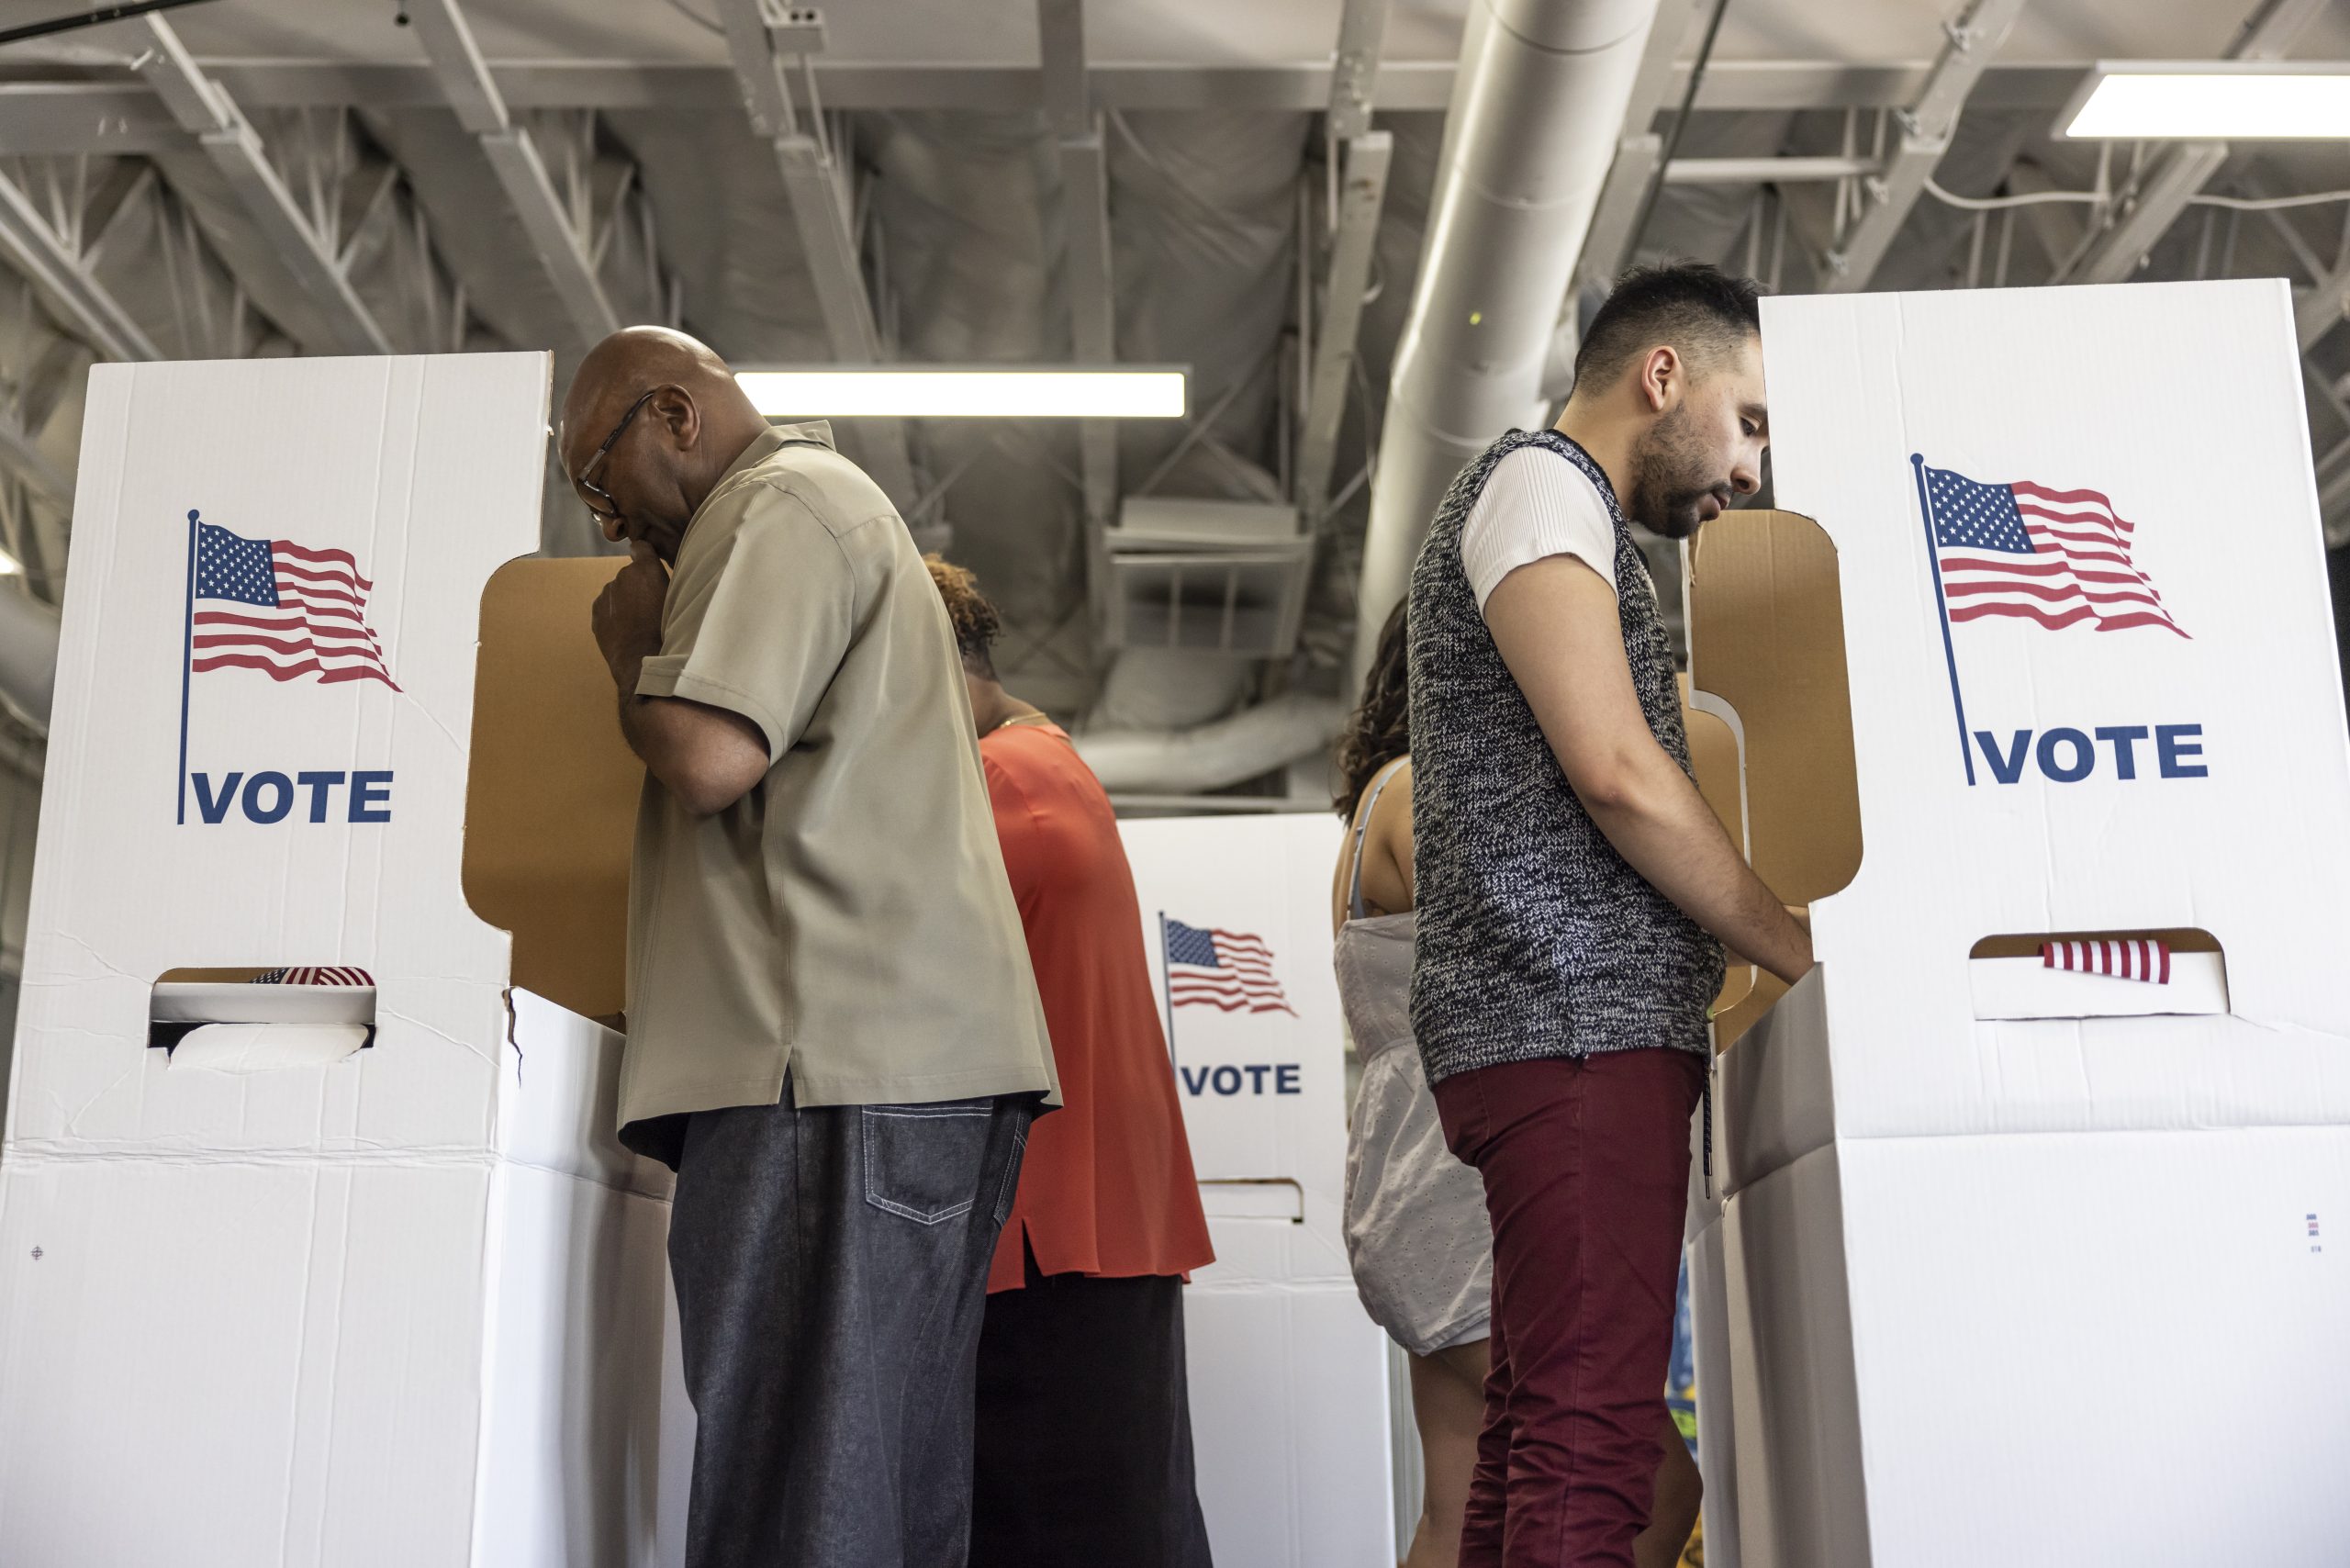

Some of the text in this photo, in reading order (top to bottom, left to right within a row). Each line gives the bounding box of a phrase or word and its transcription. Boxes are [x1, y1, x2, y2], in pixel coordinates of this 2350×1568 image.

[1973, 723, 2209, 783] VOTE
[191, 770, 394, 824] VOTE
[1181, 1064, 1302, 1095] VOTE
